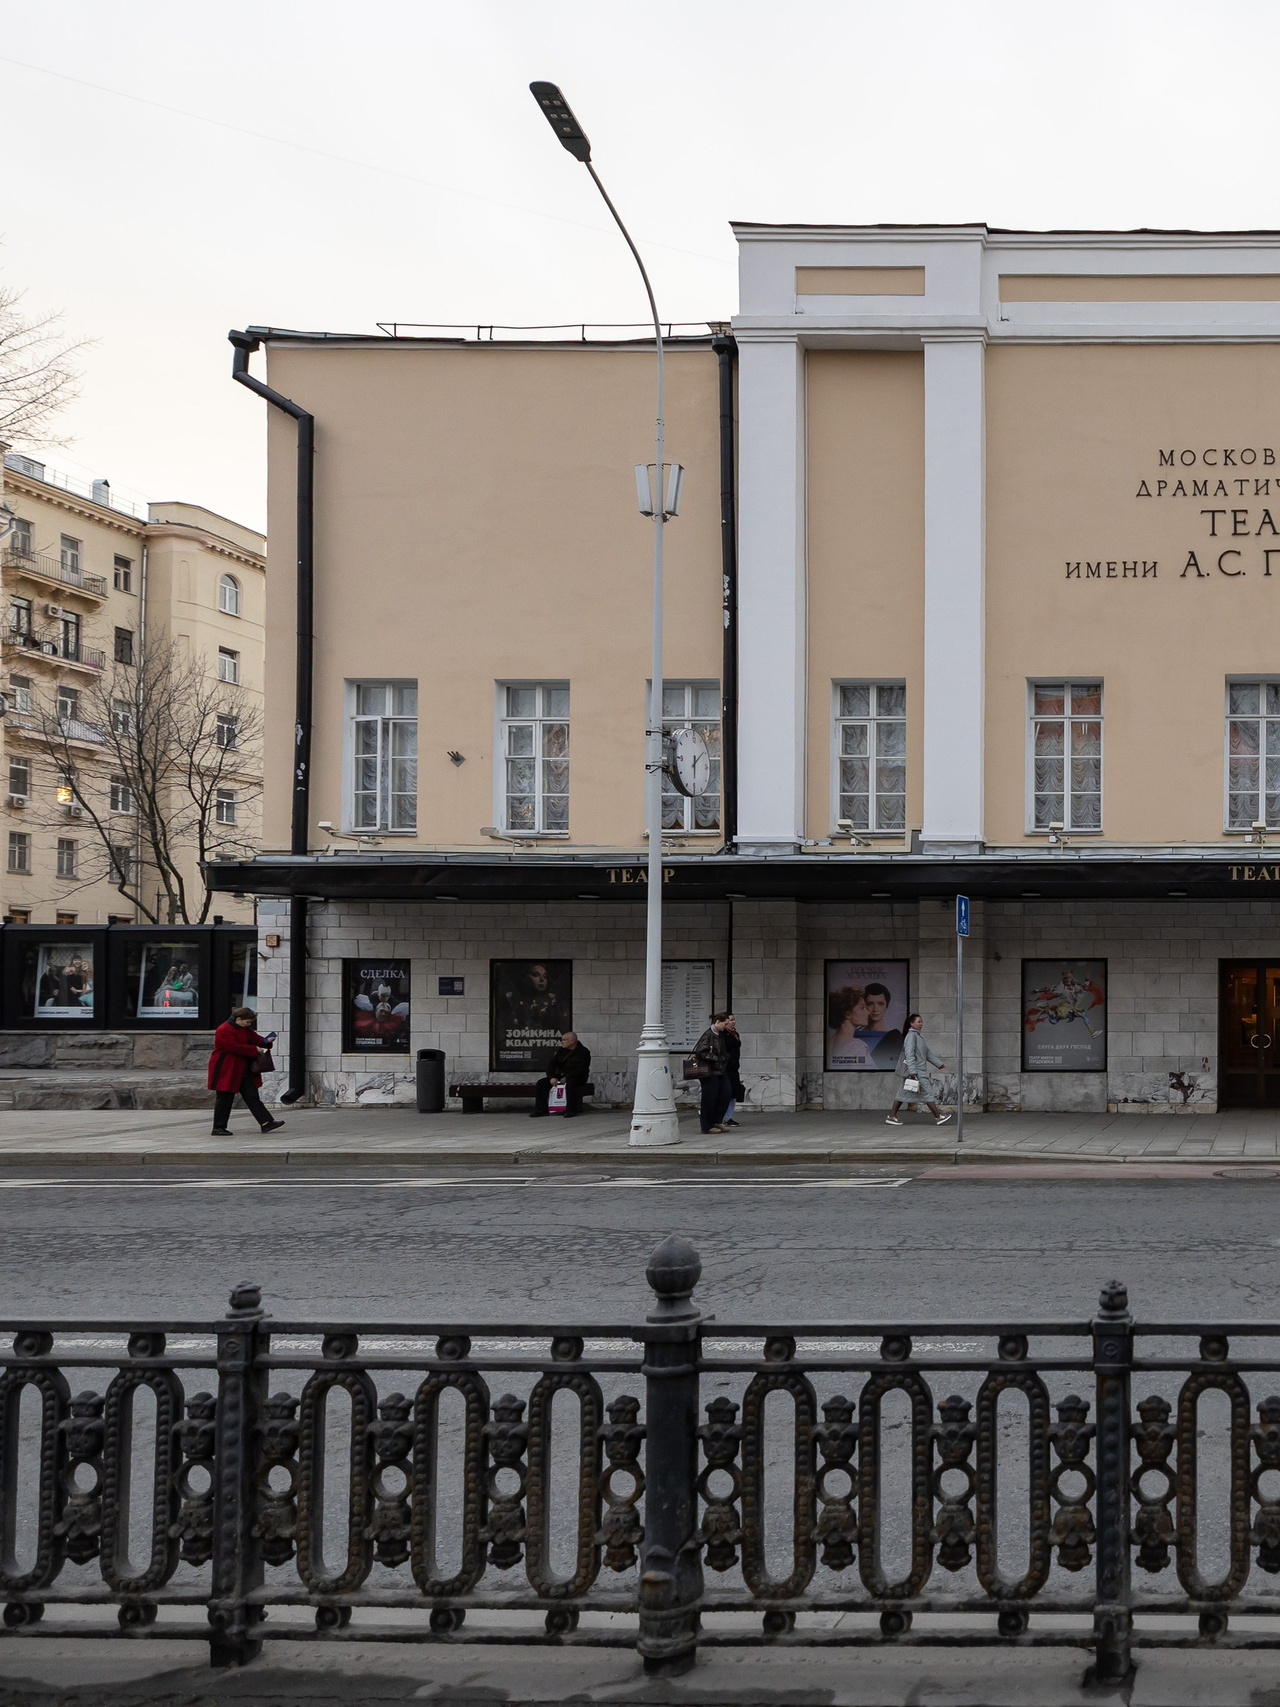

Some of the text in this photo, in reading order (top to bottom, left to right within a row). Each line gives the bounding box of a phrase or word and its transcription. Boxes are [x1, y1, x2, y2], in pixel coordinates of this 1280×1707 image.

[1065, 560, 1159, 579] ИМЕНИ
[606, 868, 675, 884] ТЕАР
[360, 969, 405, 980] СДЕЛКА
[505, 1027, 563, 1038] ЗОЙКИНА
[505, 1038, 563, 1047] КВАРТИРА
